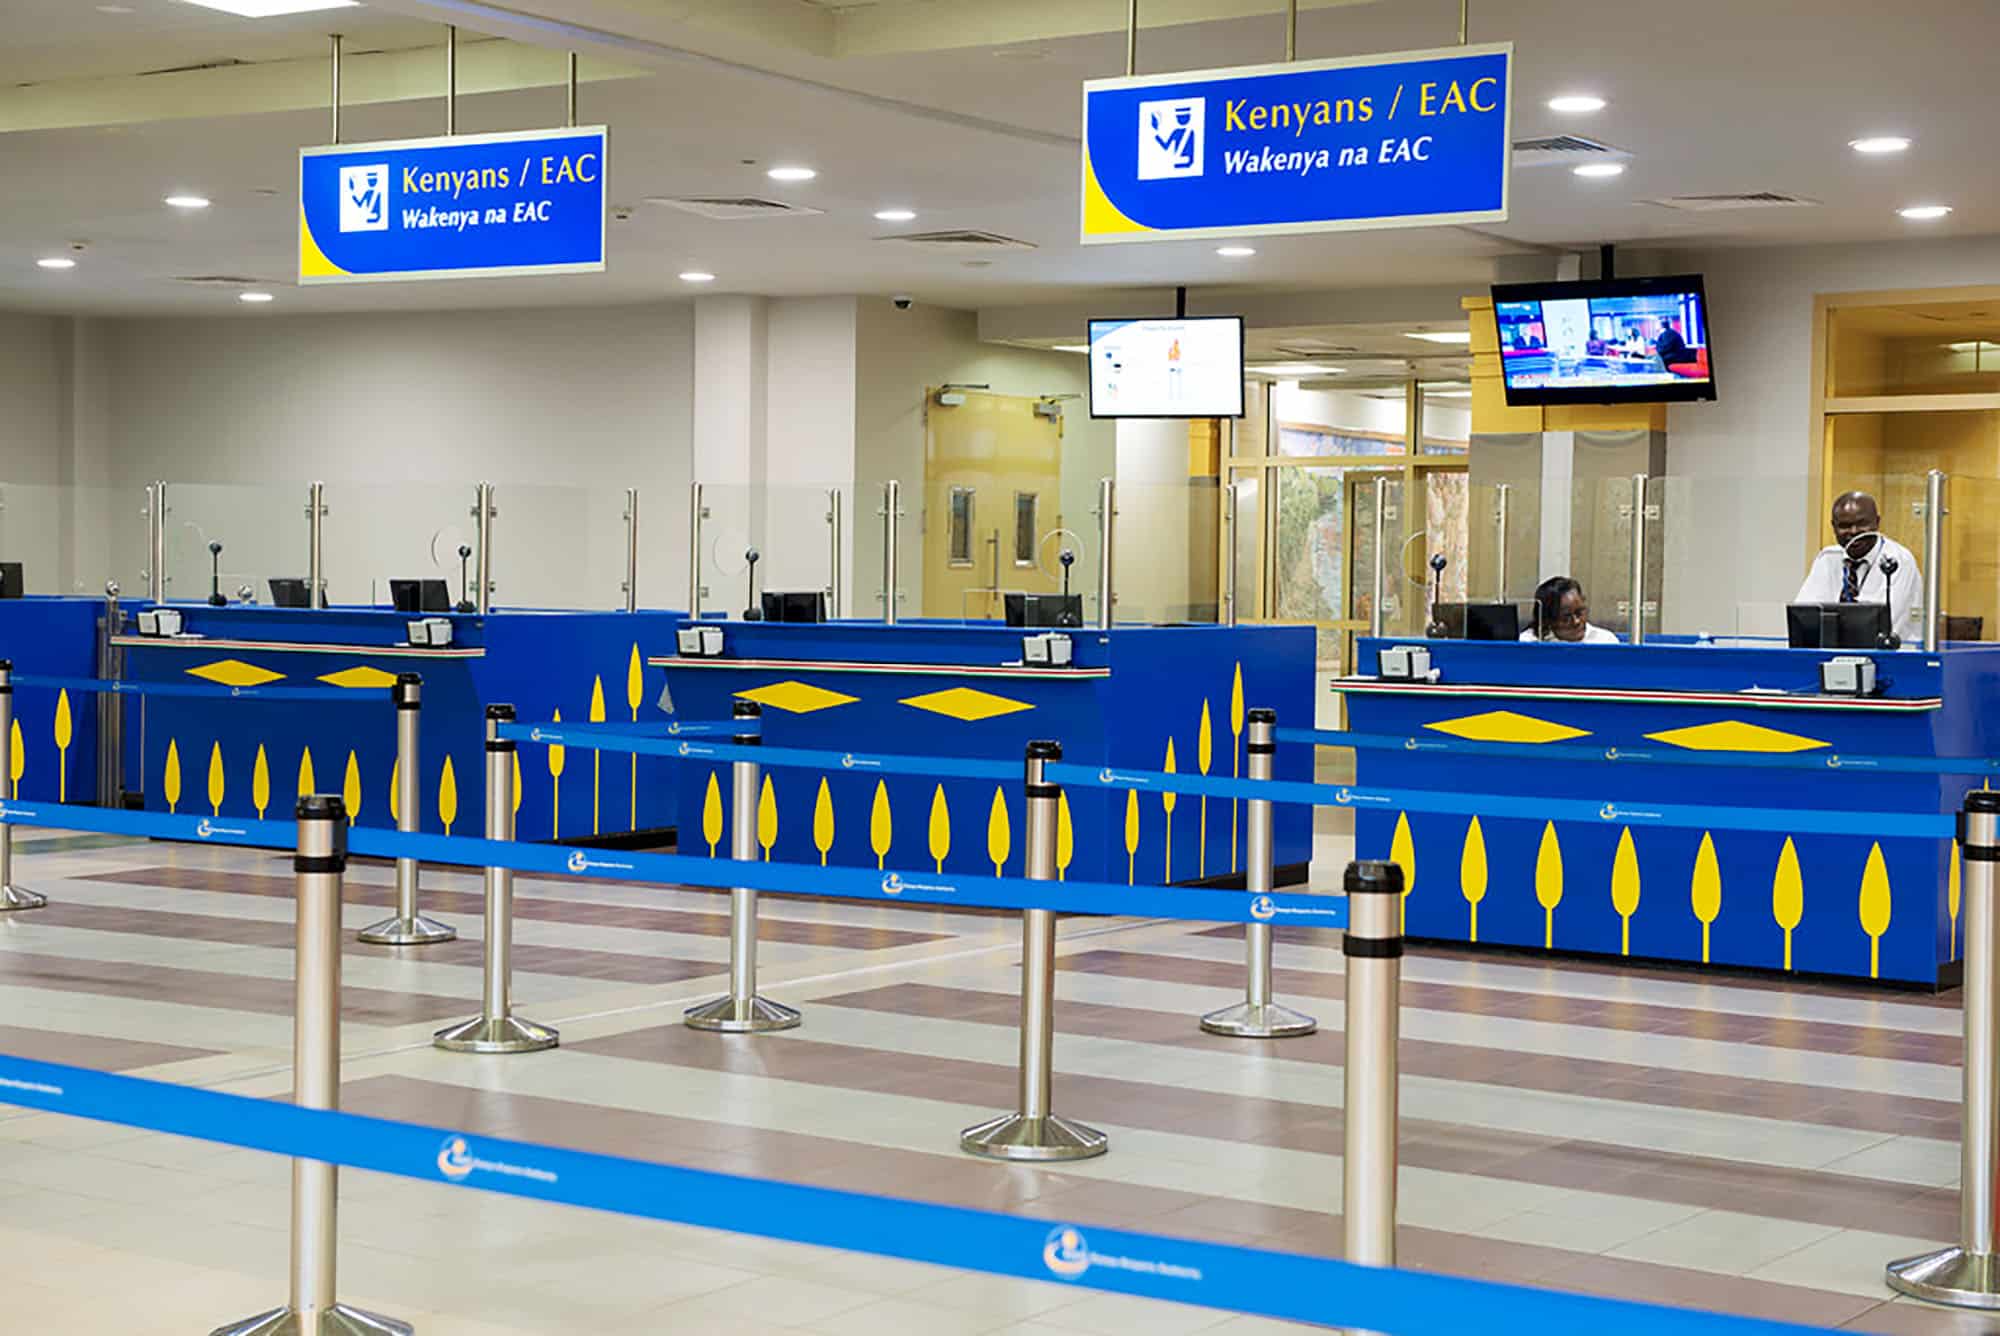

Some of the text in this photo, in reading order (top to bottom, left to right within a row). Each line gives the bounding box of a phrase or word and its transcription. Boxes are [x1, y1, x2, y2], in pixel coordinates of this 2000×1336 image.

[1224, 77, 1498, 137] Kenyans / EAC
[402, 153, 596, 199] Kenyans / EAC
[1223, 136, 1433, 176] Wakenya na EAC
[402, 200, 552, 232] Wakenya na EAC
